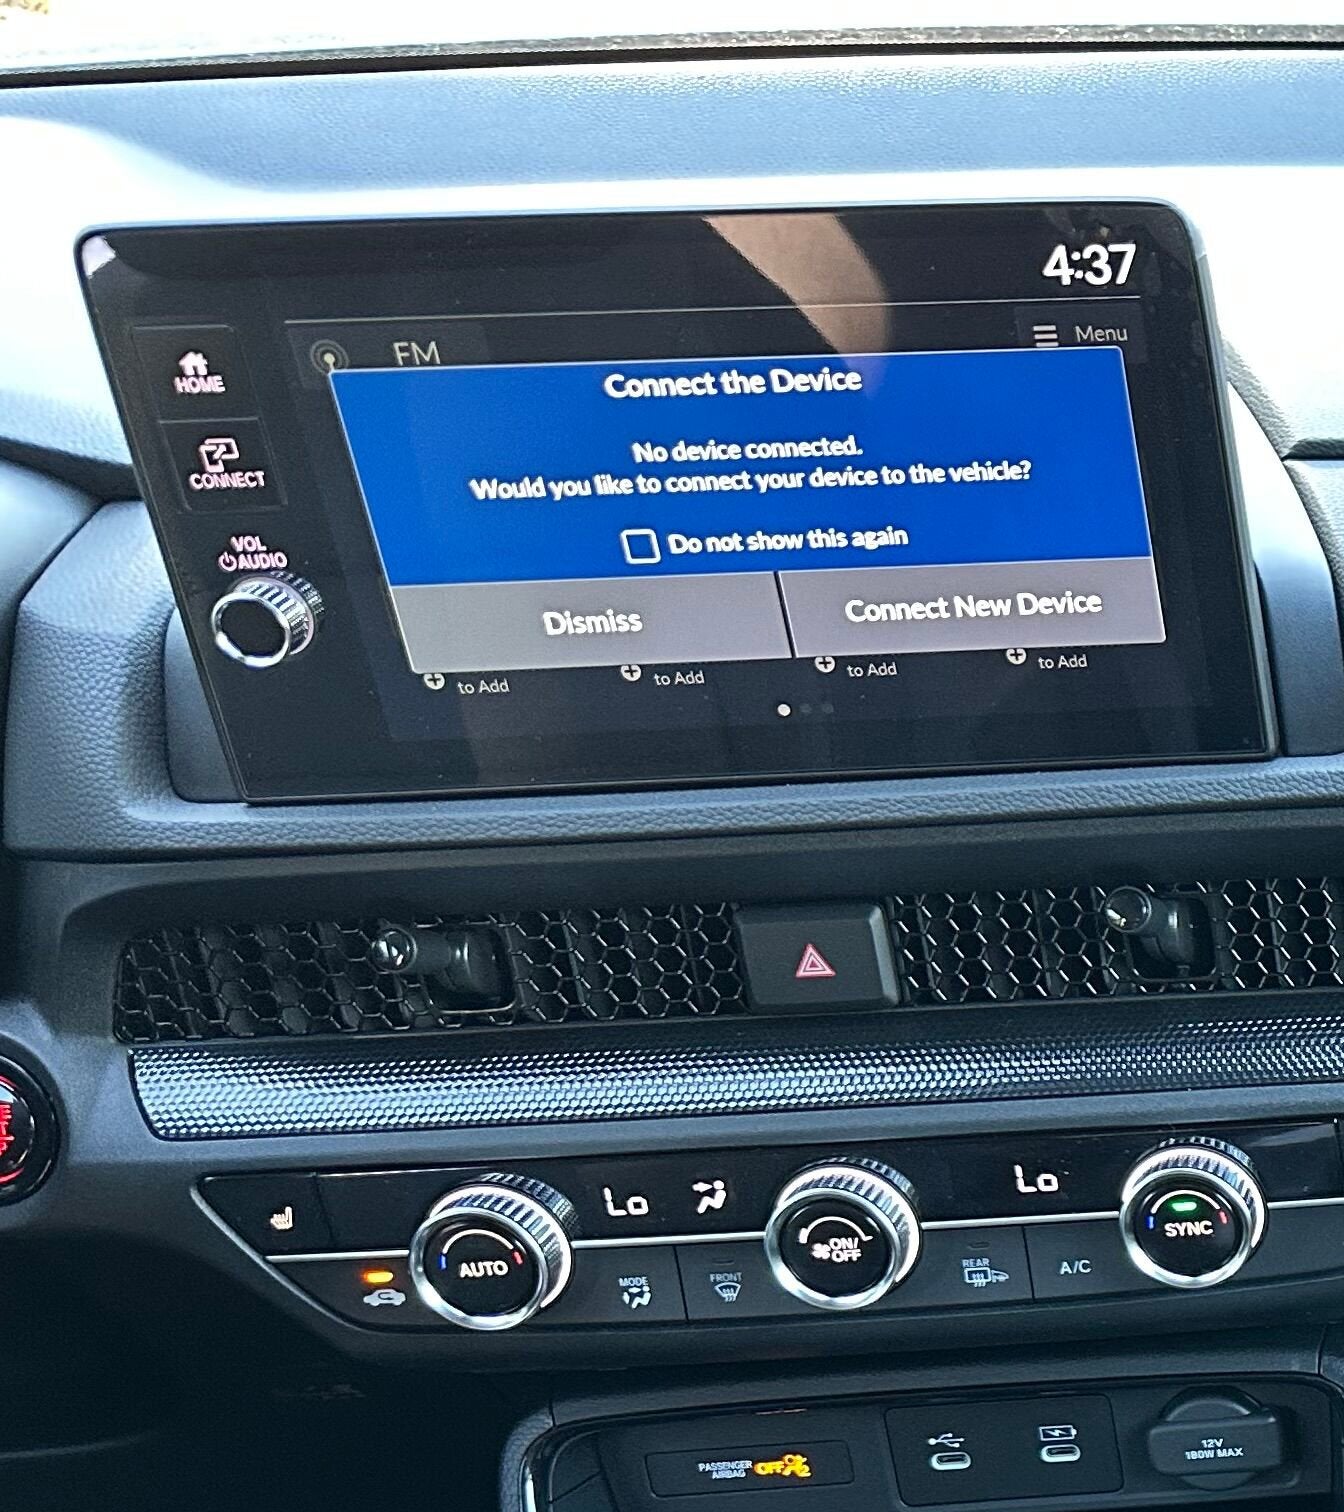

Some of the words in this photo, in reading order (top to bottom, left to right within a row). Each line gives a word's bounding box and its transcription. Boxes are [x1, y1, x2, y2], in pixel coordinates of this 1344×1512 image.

[1043, 243, 1138, 286] 4:37
[1075, 324, 1129, 344] Menu
[392, 341, 441, 366] FM
[174, 375, 226, 393] HOME
[603, 371, 718, 398] Connect
[720, 369, 766, 395] the
[770, 367, 863, 394] Device
[631, 441, 669, 463] No
[672, 439, 742, 461] device
[745, 435, 864, 460] connected.
[189, 470, 266, 490] CONNECT
[469, 476, 546, 500] Would
[549, 475, 592, 501] you
[594, 473, 634, 495] like
[635, 475, 662, 494] to
[665, 470, 753, 493] connect
[755, 472, 806, 494] your
[809, 465, 878, 488] device
[880, 465, 906, 486] to
[909, 462, 946, 484] the
[948, 459, 1032, 483] vehicle?
[230, 535, 267, 552] VOL
[667, 533, 703, 555] Do
[706, 532, 744, 553] not
[747, 530, 804, 550] show
[806, 527, 848, 549] this
[851, 525, 909, 550] again
[237, 551, 288, 570] AUDIO
[844, 596, 951, 623] Connect
[952, 594, 1012, 620] New
[1016, 590, 1103, 617] Device
[542, 608, 643, 636] Dismiss
[847, 663, 864, 678] to
[867, 661, 898, 677] Add
[1037, 656, 1054, 670] to
[1057, 653, 1088, 669] Add
[457, 680, 476, 695] to
[478, 678, 510, 694] Add
[653, 671, 671, 687] to
[673, 669, 705, 686] Add
[1013, 1164, 1059, 1193] Lo
[603, 1187, 649, 1217] Lo
[1164, 1220, 1214, 1239] SYNC
[829, 1237, 859, 1250] ON/
[832, 1249, 862, 1263] OFF
[962, 1258, 990, 1268] REAR
[459, 1260, 509, 1279] AUTO
[1059, 1259, 1092, 1275] A/C
[618, 1276, 648, 1287] MODE
[710, 1272, 743, 1283] FRONT
[1201, 1438, 1224, 1448] 12V
[1185, 1449, 1215, 1460] 180W
[1216, 1447, 1244, 1458] MAX
[698, 1460, 753, 1472] PASSENGER
[754, 1460, 785, 1475] OFF
